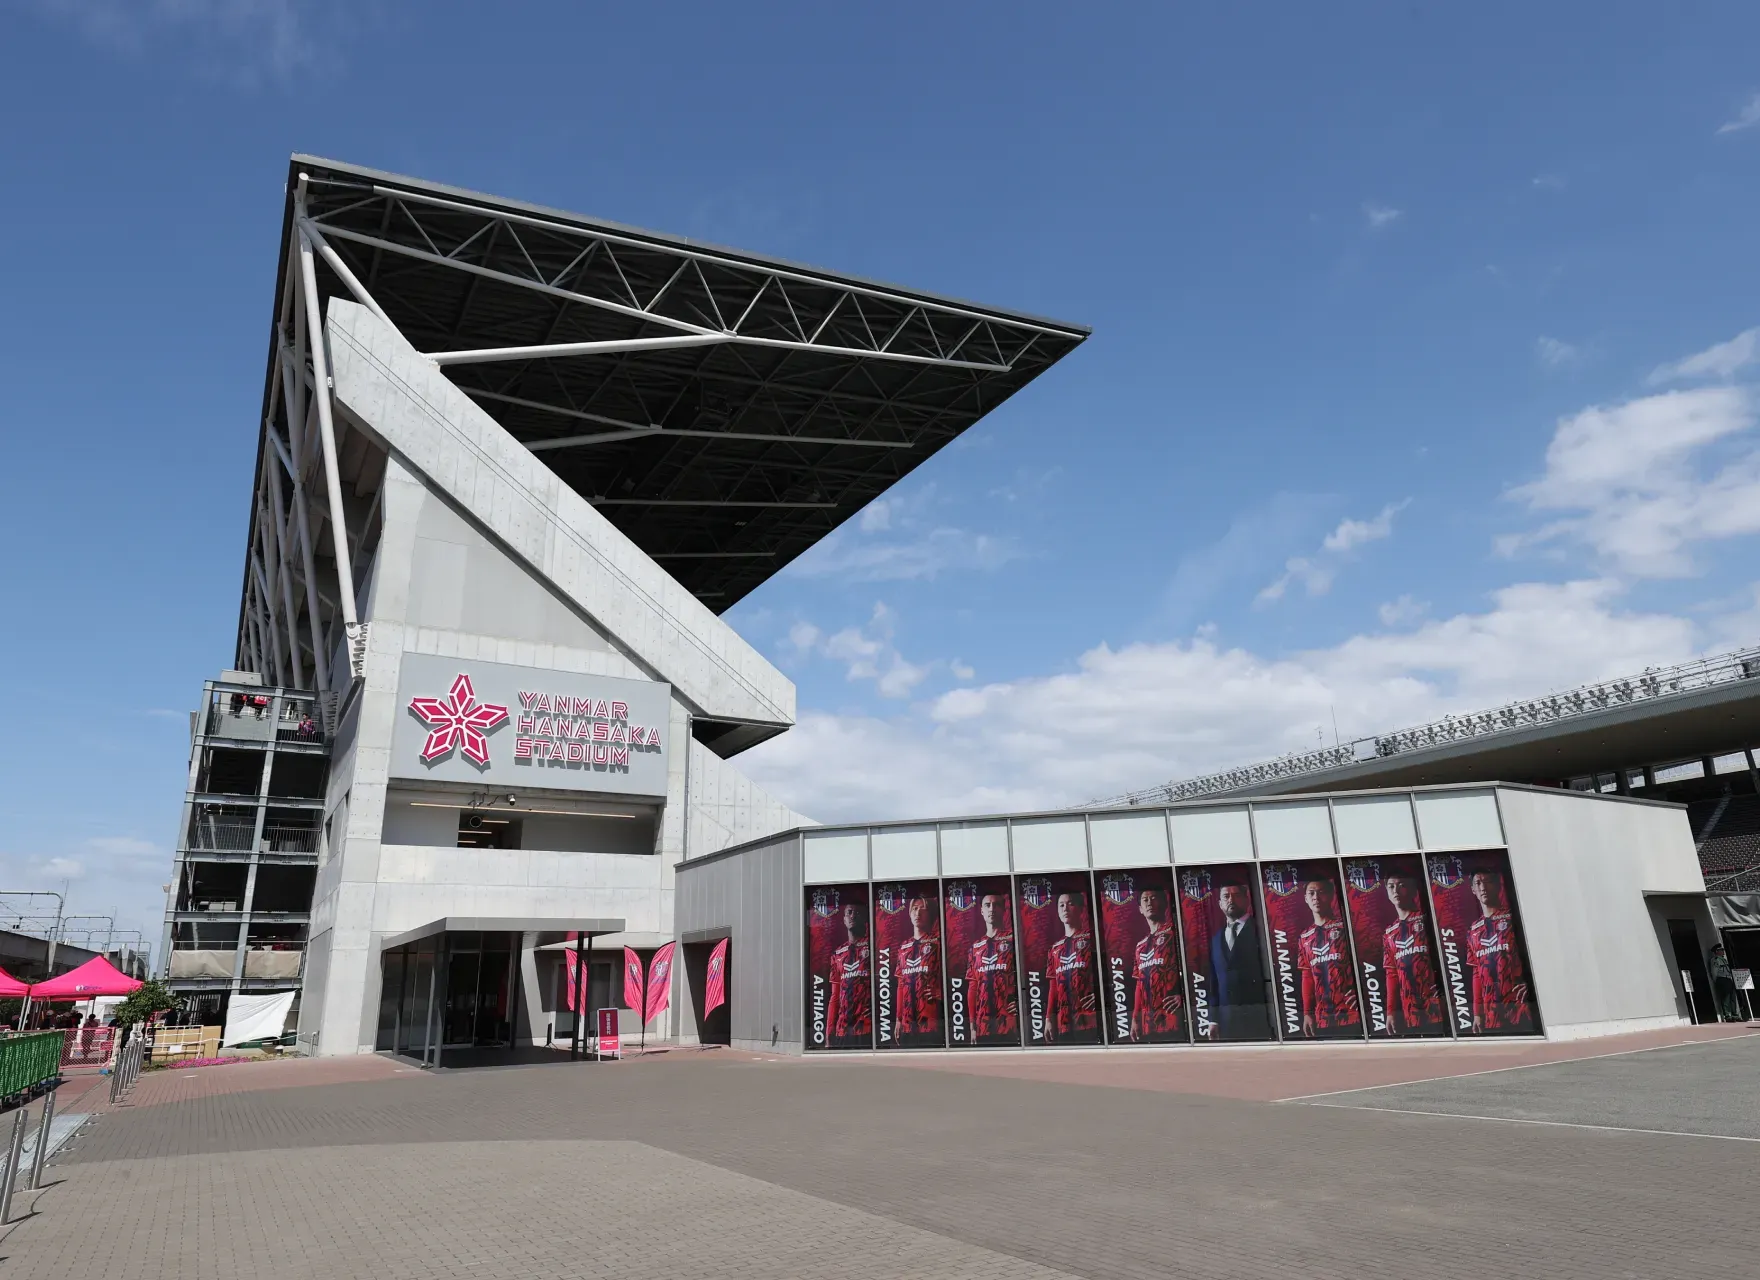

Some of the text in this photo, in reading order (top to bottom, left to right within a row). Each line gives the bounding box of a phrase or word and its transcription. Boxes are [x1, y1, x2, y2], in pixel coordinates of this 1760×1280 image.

[516, 714, 662, 746] HANASAKA
[519, 690, 629, 719] YANMAR
[514, 737, 630, 765] STADIUM
[840, 970, 868, 980] ANMAR
[1273, 929, 1301, 1034] M.NAKAJIMA
[1310, 952, 1342, 967] NMAR
[1395, 945, 1428, 960] ANMAR
[1440, 928, 1472, 1029] S.HATANAKA
[813, 974, 824, 1044] A.THIAGO
[879, 948, 891, 1042] Y.YOKOYAMA
[951, 977, 965, 1041] D.COOLS
[1028, 971, 1043, 1040] H.OKUDA
[1110, 957, 1130, 1038] S.KAGAWA
[1192, 972, 1210, 1037] A.PAPAS
[1363, 961, 1386, 1032] A.OHATA
